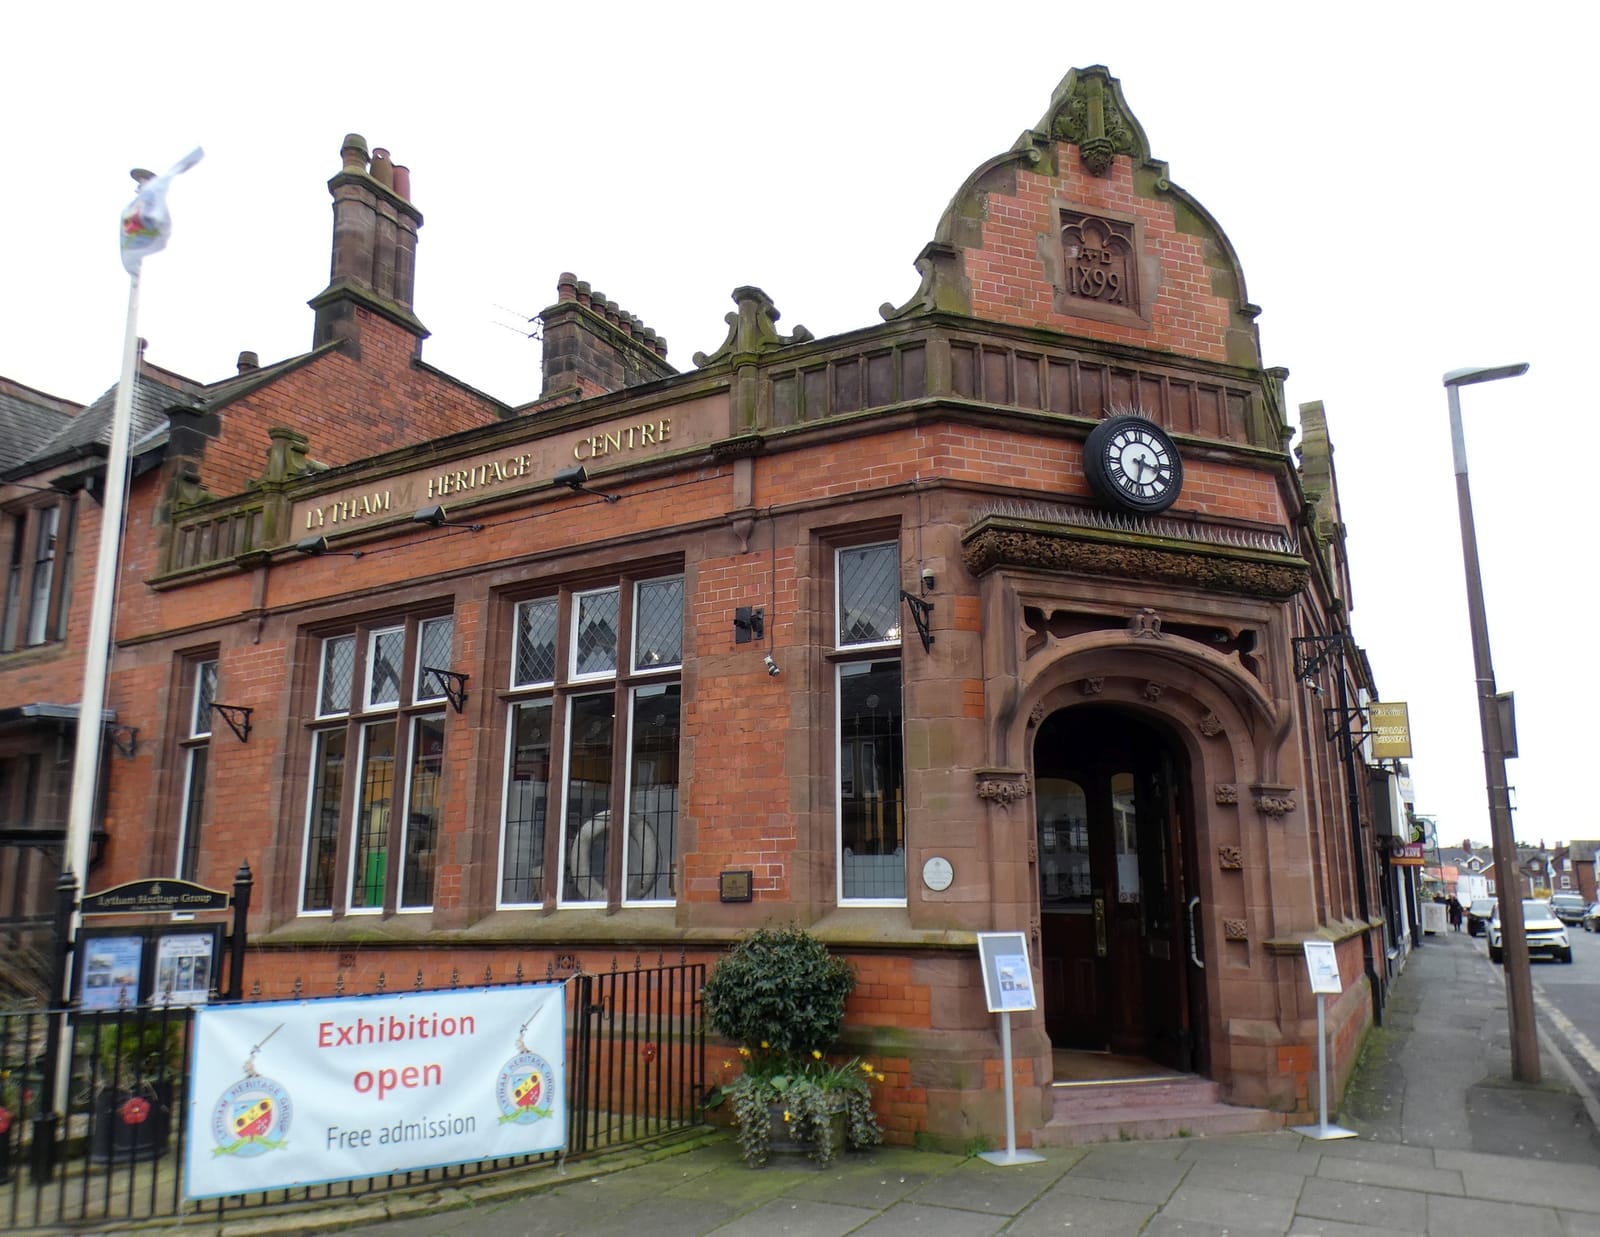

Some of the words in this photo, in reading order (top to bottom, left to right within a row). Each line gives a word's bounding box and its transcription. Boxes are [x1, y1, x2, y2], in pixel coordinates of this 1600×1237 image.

[306, 490, 391, 530] LYTHAM
[427, 453, 532, 499] HERITAGE
[573, 418, 672, 462] CENTRE
[97, 895, 136, 907] Lytham
[138, 893, 179, 905] Heritage
[181, 894, 212, 904] Group
[318, 1012, 475, 1049] Exhibition
[353, 1063, 443, 1101] open
[326, 1126, 373, 1151] Free
[379, 1113, 476, 1146] admission
